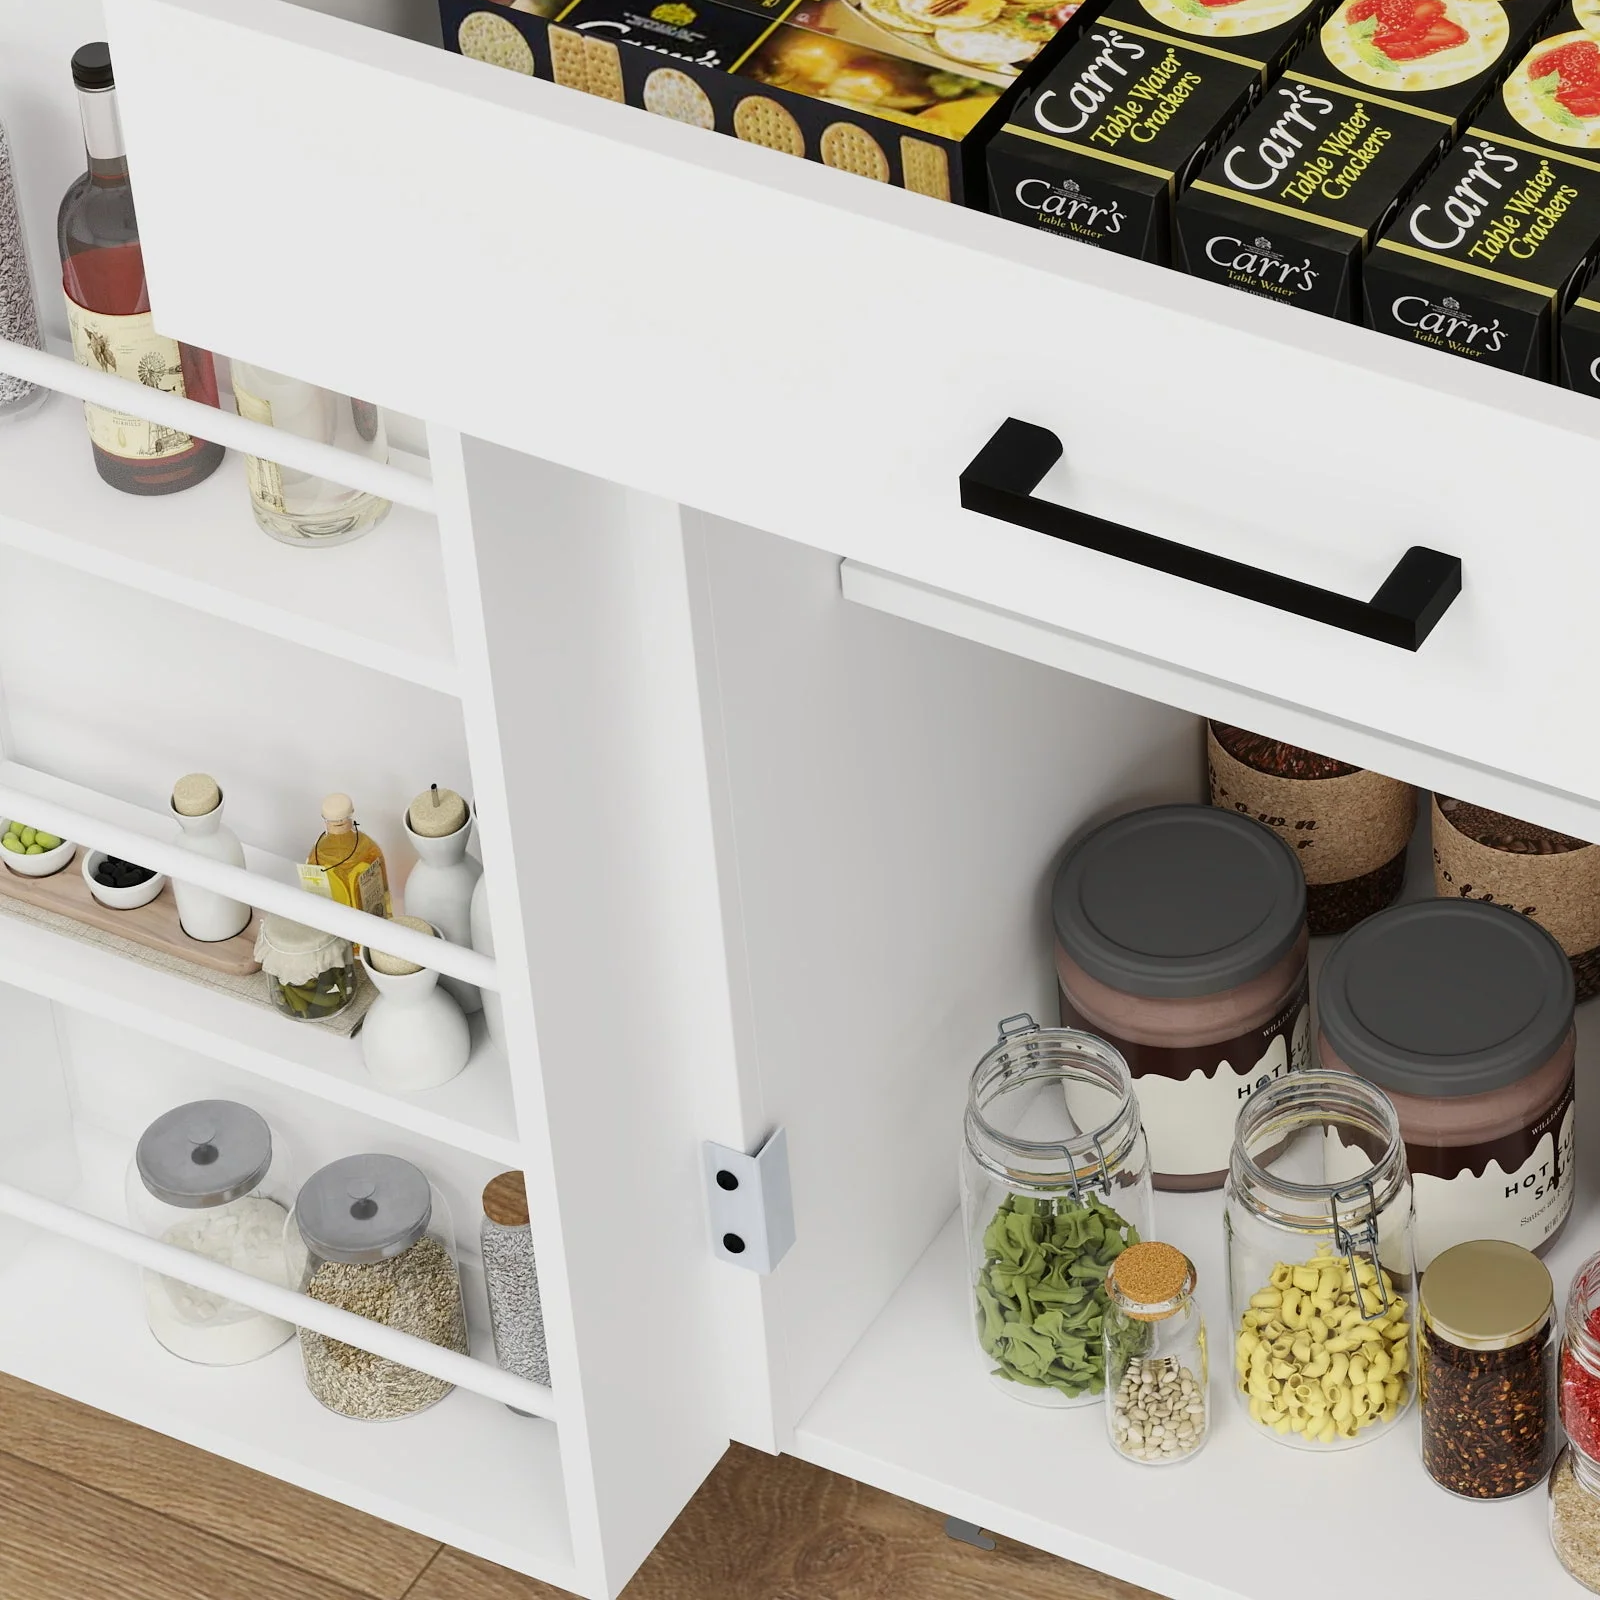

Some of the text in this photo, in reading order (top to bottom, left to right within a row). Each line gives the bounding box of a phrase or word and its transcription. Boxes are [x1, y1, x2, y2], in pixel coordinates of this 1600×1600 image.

[1034, 30, 1145, 134] Carr's
[1130, 71, 1202, 143] Crackers
[1090, 99, 1143, 147] Table
[1224, 84, 1334, 190] Carr's
[1281, 155, 1333, 203] Table
[1321, 126, 1392, 200] Crackers
[1015, 178, 1127, 233] Carr's
[1037, 211, 1067, 228] Table
[1409, 141, 1519, 250] Carr's
[1509, 184, 1579, 259] Crackers
[1205, 236, 1320, 291] Carr's
[1468, 214, 1521, 263] Table
[1227, 269, 1257, 286] Table
[1391, 296, 1508, 352] Carr's
[1413, 329, 1444, 346] Table
[1505, 1161, 1549, 1198] HOT
[1520, 1204, 1546, 1227] Sauce
